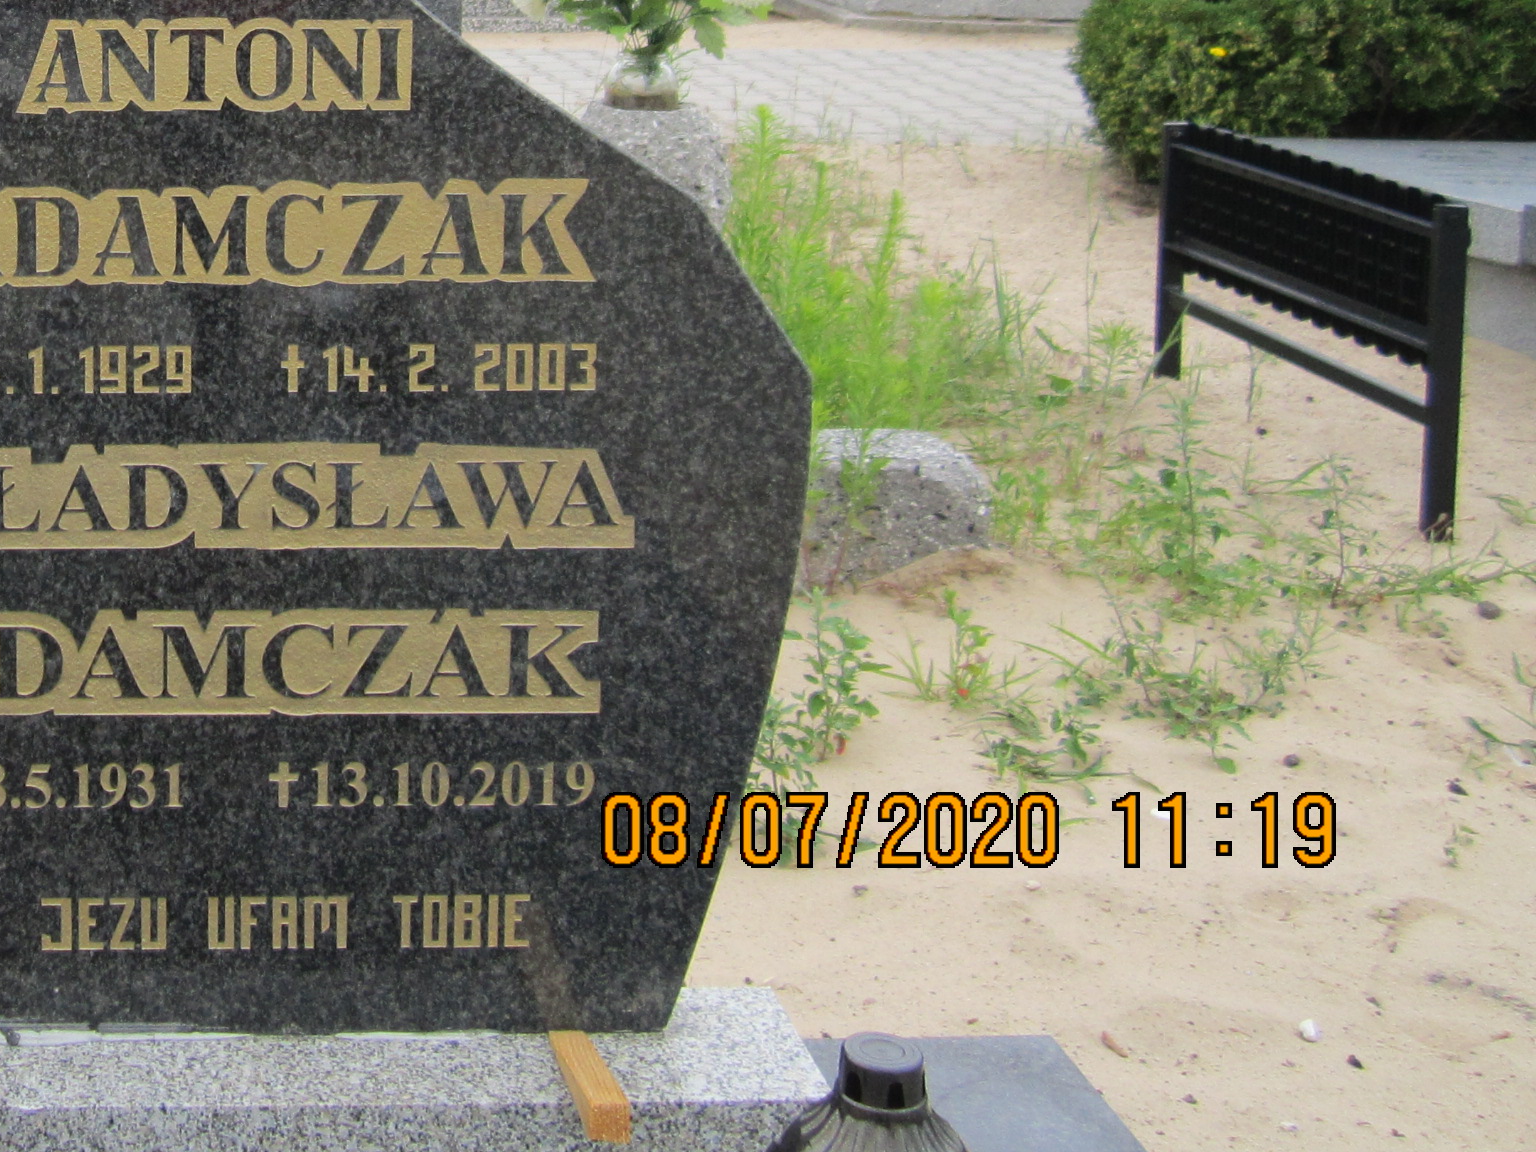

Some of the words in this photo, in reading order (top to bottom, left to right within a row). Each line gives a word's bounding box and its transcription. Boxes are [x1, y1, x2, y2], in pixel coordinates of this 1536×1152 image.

[32, 25, 406, 105] ANTONI
[78, 344, 193, 395] 1929
[474, 342, 598, 393] 2003
[311, 759, 596, 809] 13.10.2019
[39, 896, 169, 951] JEZU
[207, 894, 350, 949] UFAM
[392, 893, 531, 948] TOBIE
